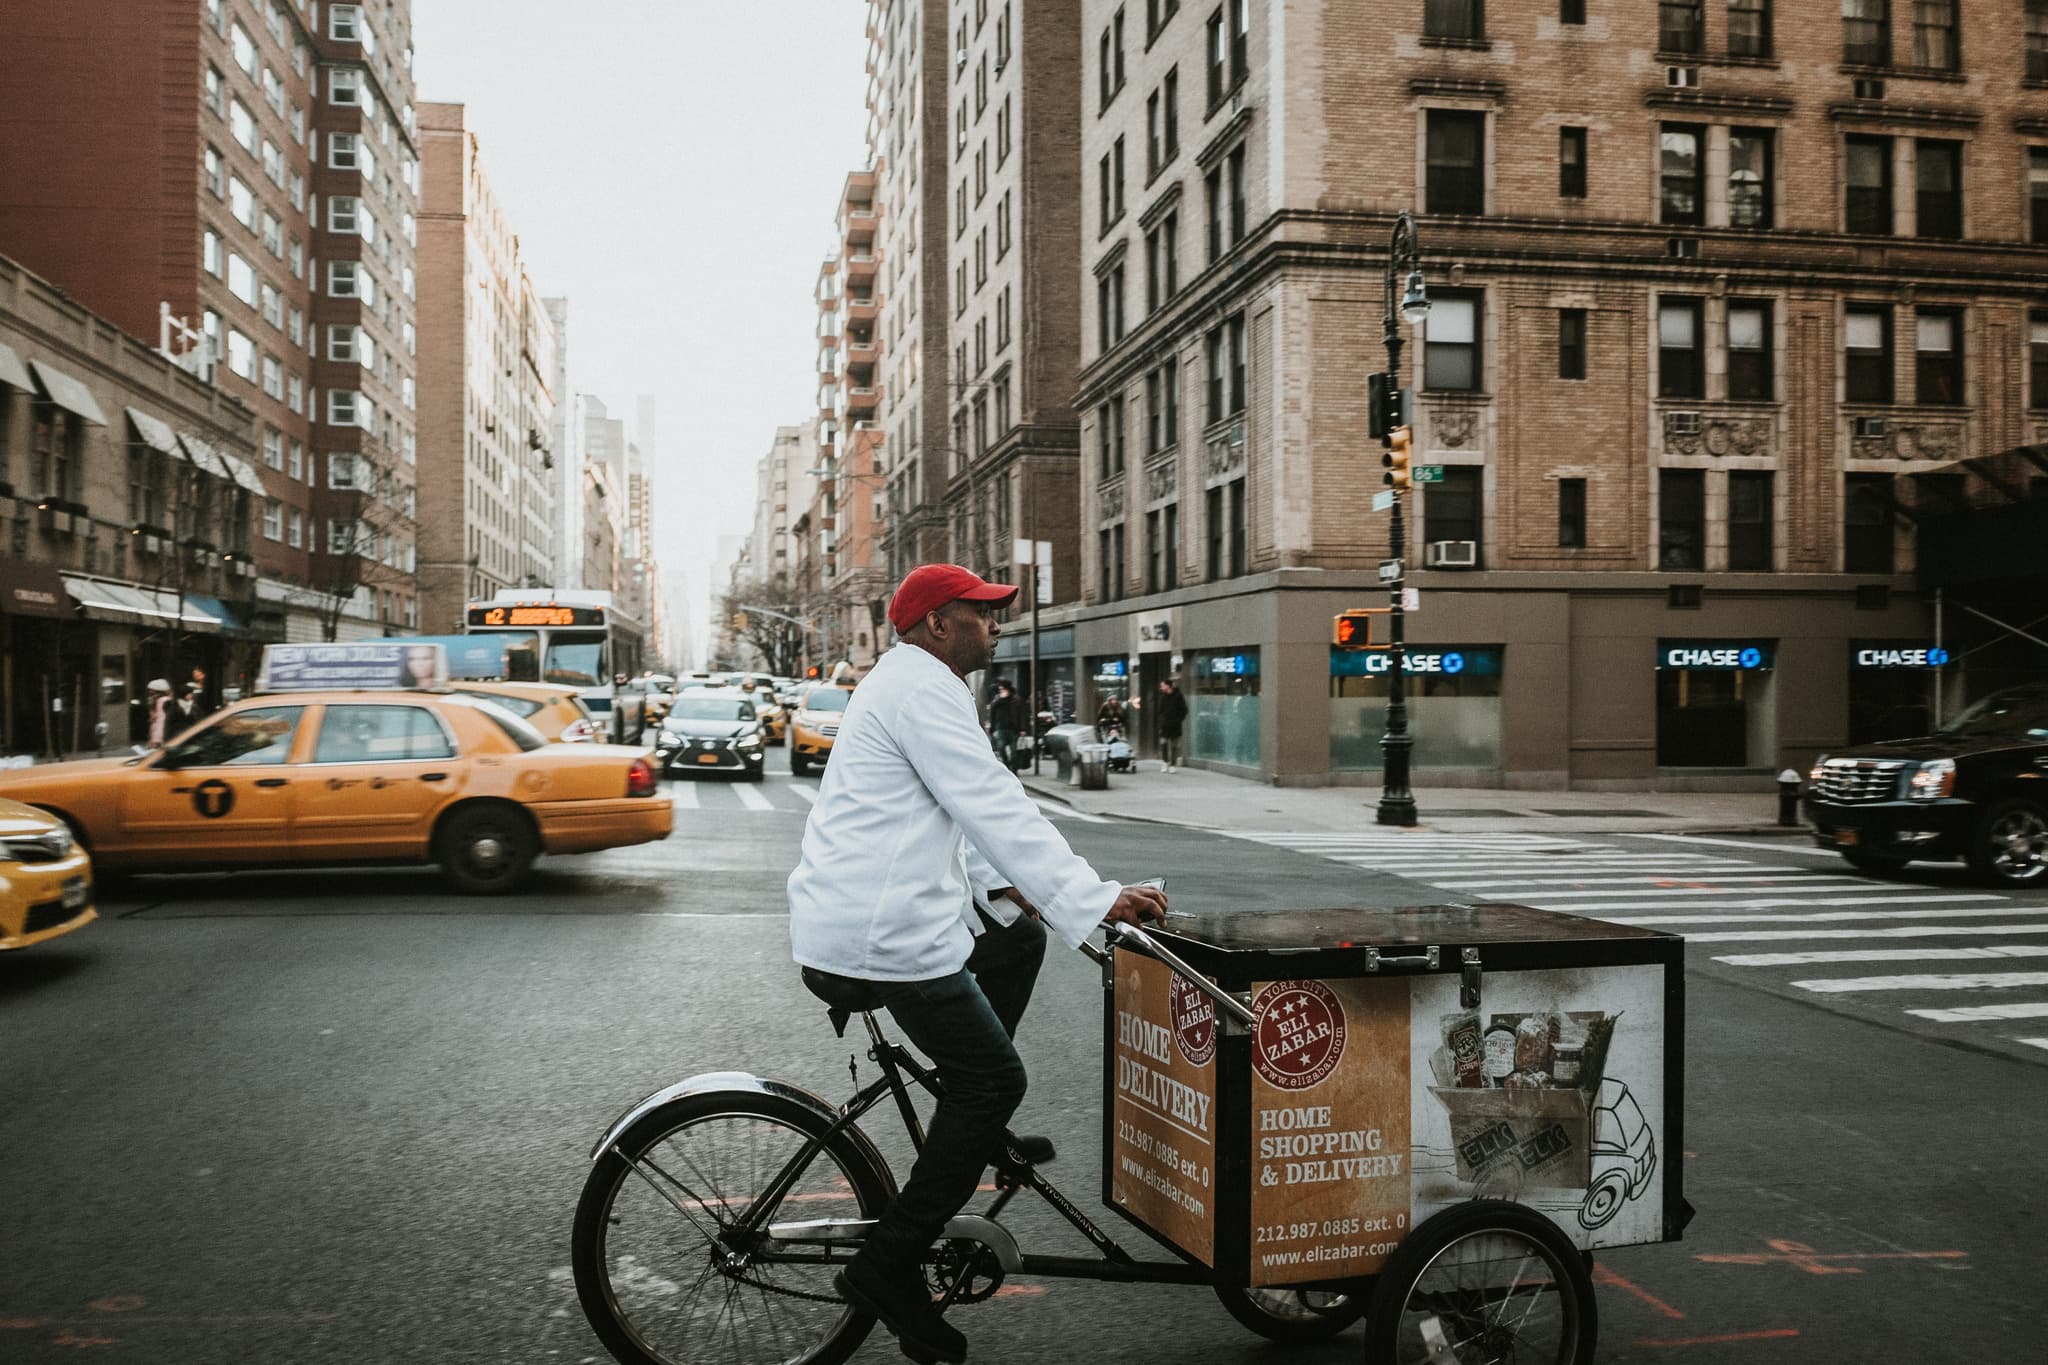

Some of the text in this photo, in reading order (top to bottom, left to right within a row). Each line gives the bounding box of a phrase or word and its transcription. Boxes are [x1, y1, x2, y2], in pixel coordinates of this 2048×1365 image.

[1415, 467, 1432, 480] 86
[1365, 654, 1442, 672] CHASE
[1668, 649, 1740, 666] CHASE
[1858, 649, 1928, 666] CHASE
[1183, 990, 1202, 1011] ELI
[1264, 980, 1297, 1001] YORK
[1302, 980, 1329, 999] CITY
[1180, 1003, 1213, 1030] ZABAR
[1276, 1012, 1311, 1038] ELI
[1118, 1010, 1171, 1066] HOME
[1267, 1021, 1332, 1061] ZABAR
[1259, 1026, 1344, 1088] www.elizabar.com
[1118, 1055, 1211, 1133] DELIVERY
[1260, 1106, 1332, 1132] HOME
[1118, 1119, 1209, 1188] 212.987.0885 ext. 0
[1260, 1129, 1383, 1160] SHOPPING
[1260, 1154, 1404, 1187] & DELIVERY
[1121, 1153, 1205, 1219] www.elizabar.com
[1256, 1213, 1406, 1243] 212.987.0885 ext. 0
